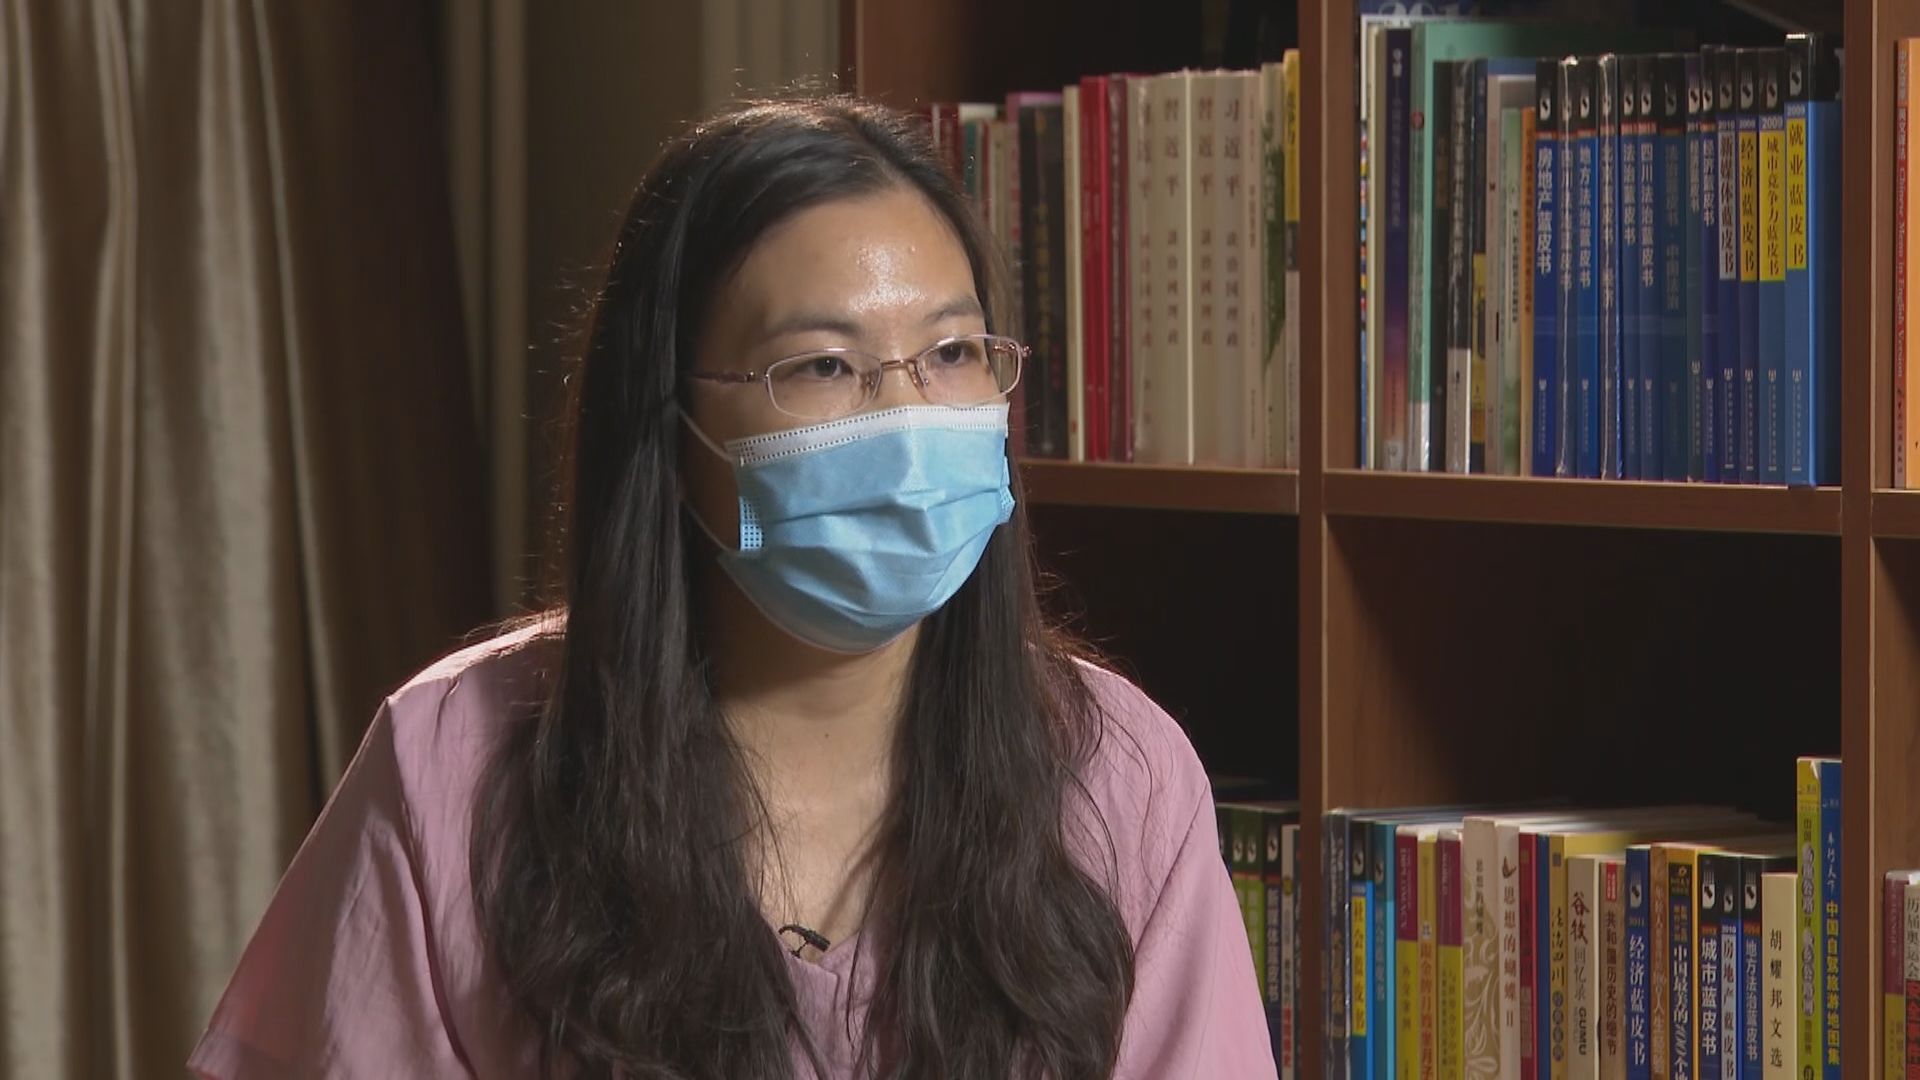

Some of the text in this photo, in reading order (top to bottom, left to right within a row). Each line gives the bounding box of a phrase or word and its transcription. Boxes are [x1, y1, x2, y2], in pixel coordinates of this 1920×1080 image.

[1762, 116, 1784, 129] 2009
[1537, 147, 1552, 276] 房地产蓝皮书
[1579, 144, 1591, 289] 地方法治蓝皮书
[1623, 142, 1636, 246] 法治蓝皮书
[1640, 142, 1653, 289] 四川法治蓝皮书
[1740, 137, 1754, 273] 经济蓝皮书
[1767, 137, 1780, 276] 城市竞争力蓝皮书
[1789, 122, 1804, 265] 就业蓝皮书
[1503, 885, 1517, 1002] 思想的蝴蝶
[1605, 910, 1617, 1056] 共和国历史的细节
[1629, 934, 1645, 1066] 经济蓝皮书
[1701, 937, 1718, 1056] 城市蓝皮书
[1746, 939, 1758, 1062] 地方法治蓝皮书
[1770, 928, 1783, 1068] 胡耀邦文选
[1826, 900, 1840, 1066] 中国自驾旅游地图集
[1906, 896, 1920, 978] 历届奥运会
[1578, 1006, 1587, 1056] GUMU
[1723, 939, 1735, 1079] 房地产蓝皮书
